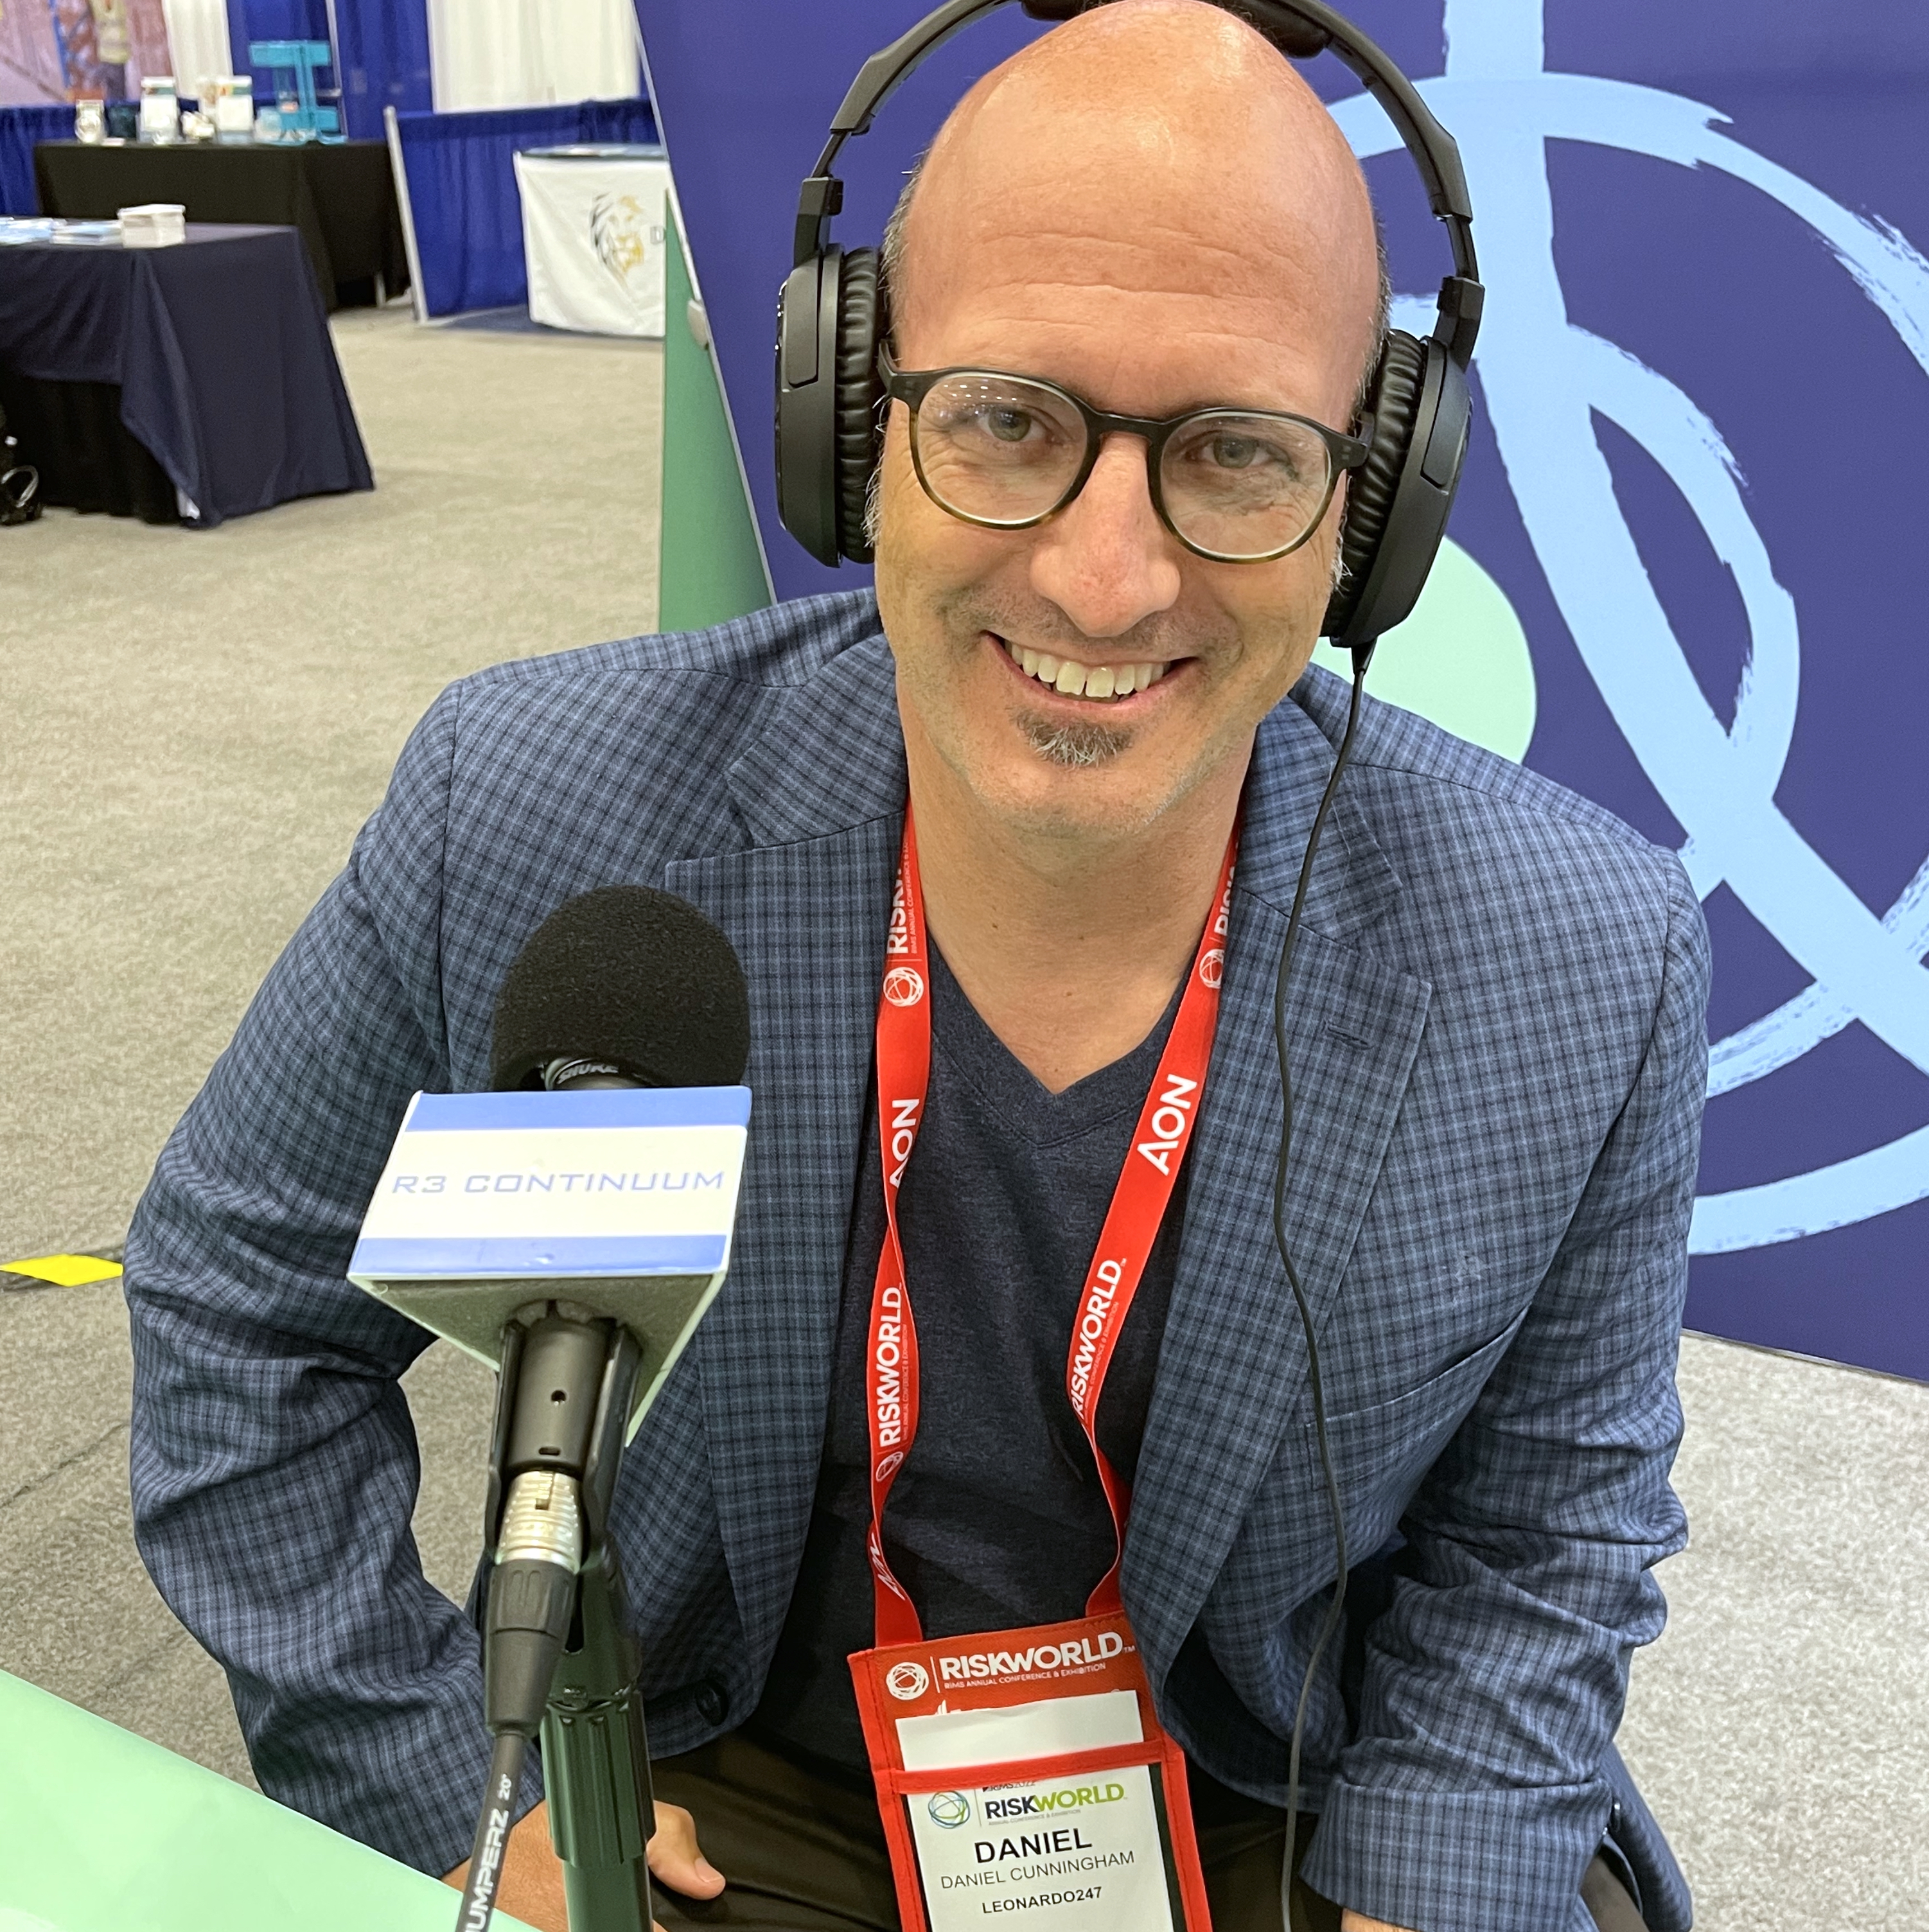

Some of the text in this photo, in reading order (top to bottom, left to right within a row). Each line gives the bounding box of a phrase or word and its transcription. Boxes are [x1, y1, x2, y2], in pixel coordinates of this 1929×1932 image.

[1138, 1073, 1197, 1177] AON
[392, 1171, 725, 1194] R3 CONTINUUM
[1071, 1260, 1122, 1419] RISKWORLD
[876, 1287, 901, 1447] RISKWORLD
[939, 1631, 1123, 1680] RISKWORLD
[944, 1680, 965, 1689] RIMS
[966, 1678, 998, 1688] ANNUAL
[999, 1671, 1052, 1684] CONFERENCE
[1061, 1662, 1106, 1676] EXHIBITION
[984, 1783, 1125, 1820] RISKWORLD
[974, 1827, 1092, 1864] DANIEL
[464, 1807, 509, 1932] UMPERZ
[940, 1850, 1135, 1890] DANIEL CUNNINGHAM
[982, 1886, 1103, 1914] LEONARDO247
